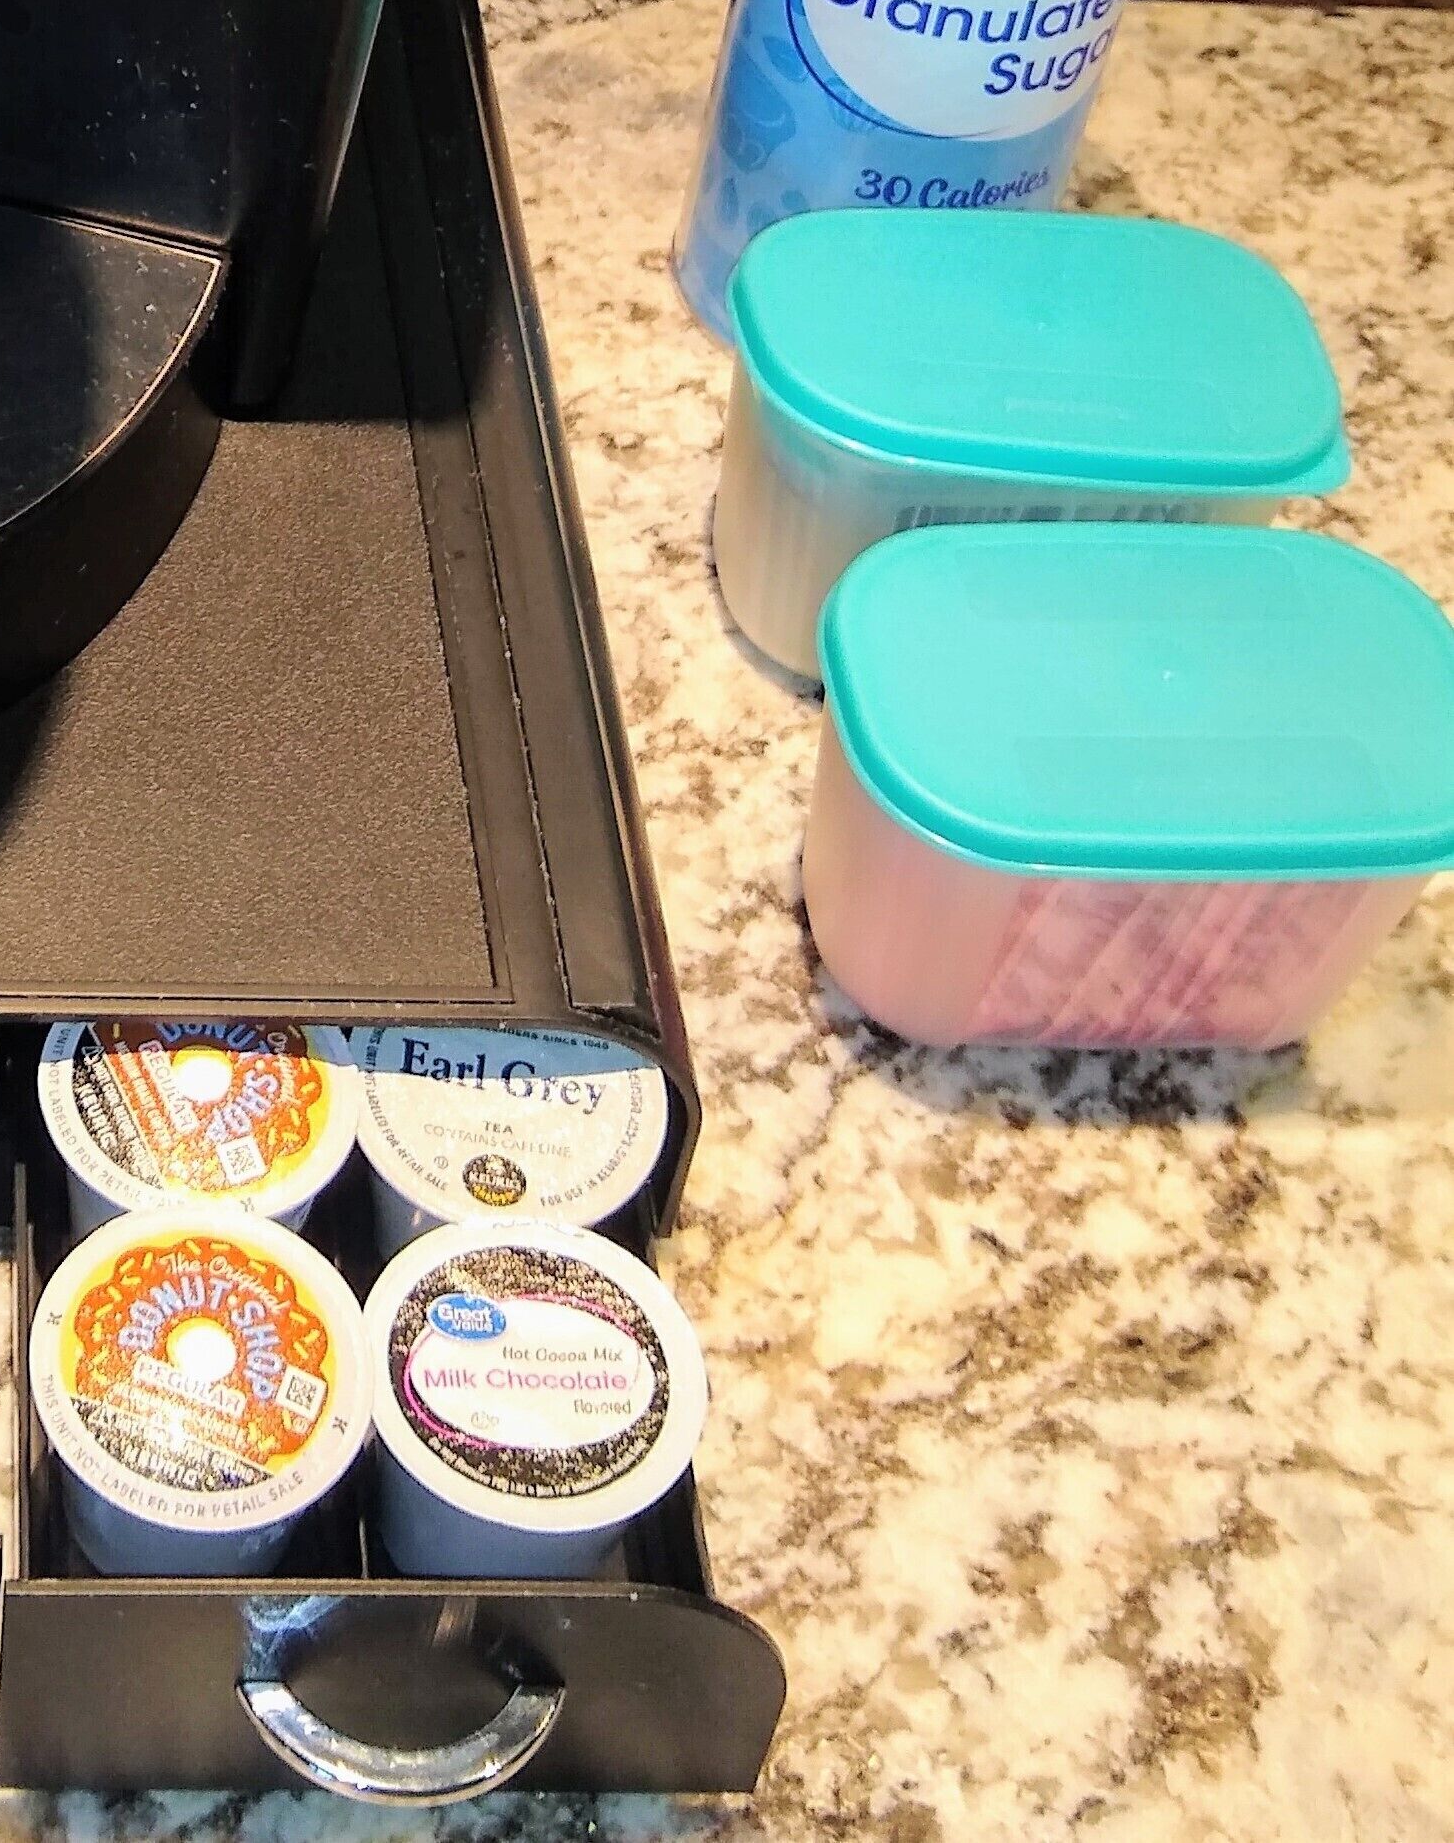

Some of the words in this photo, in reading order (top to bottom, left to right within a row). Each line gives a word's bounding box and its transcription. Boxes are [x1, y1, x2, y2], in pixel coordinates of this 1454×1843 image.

[983, 24, 1117, 96] Suga
[855, 168, 912, 204] 30
[919, 167, 1051, 210] Calories
[141, 1042, 194, 1129] REGULAR
[400, 1037, 486, 1091] Earl
[501, 1060, 607, 1115] Grey
[423, 1123, 498, 1148] CONTAINS
[483, 1120, 513, 1135] TEA
[74, 1147, 99, 1172] FOR
[158, 1252, 205, 1276] The
[206, 1253, 292, 1315] Original
[437, 1304, 495, 1322] Great
[451, 1314, 495, 1333] Value
[118, 1277, 233, 1351] DONUT
[230, 1300, 284, 1401] SHOP
[503, 1346, 530, 1362] Hot
[535, 1347, 588, 1363] Cocoa
[593, 1348, 623, 1363] Mix
[138, 1360, 241, 1413] REGULAR
[423, 1368, 478, 1391] Milk
[486, 1368, 629, 1392] Chocolate
[573, 1399, 632, 1415] Flavored
[269, 1470, 304, 1500] SALE
